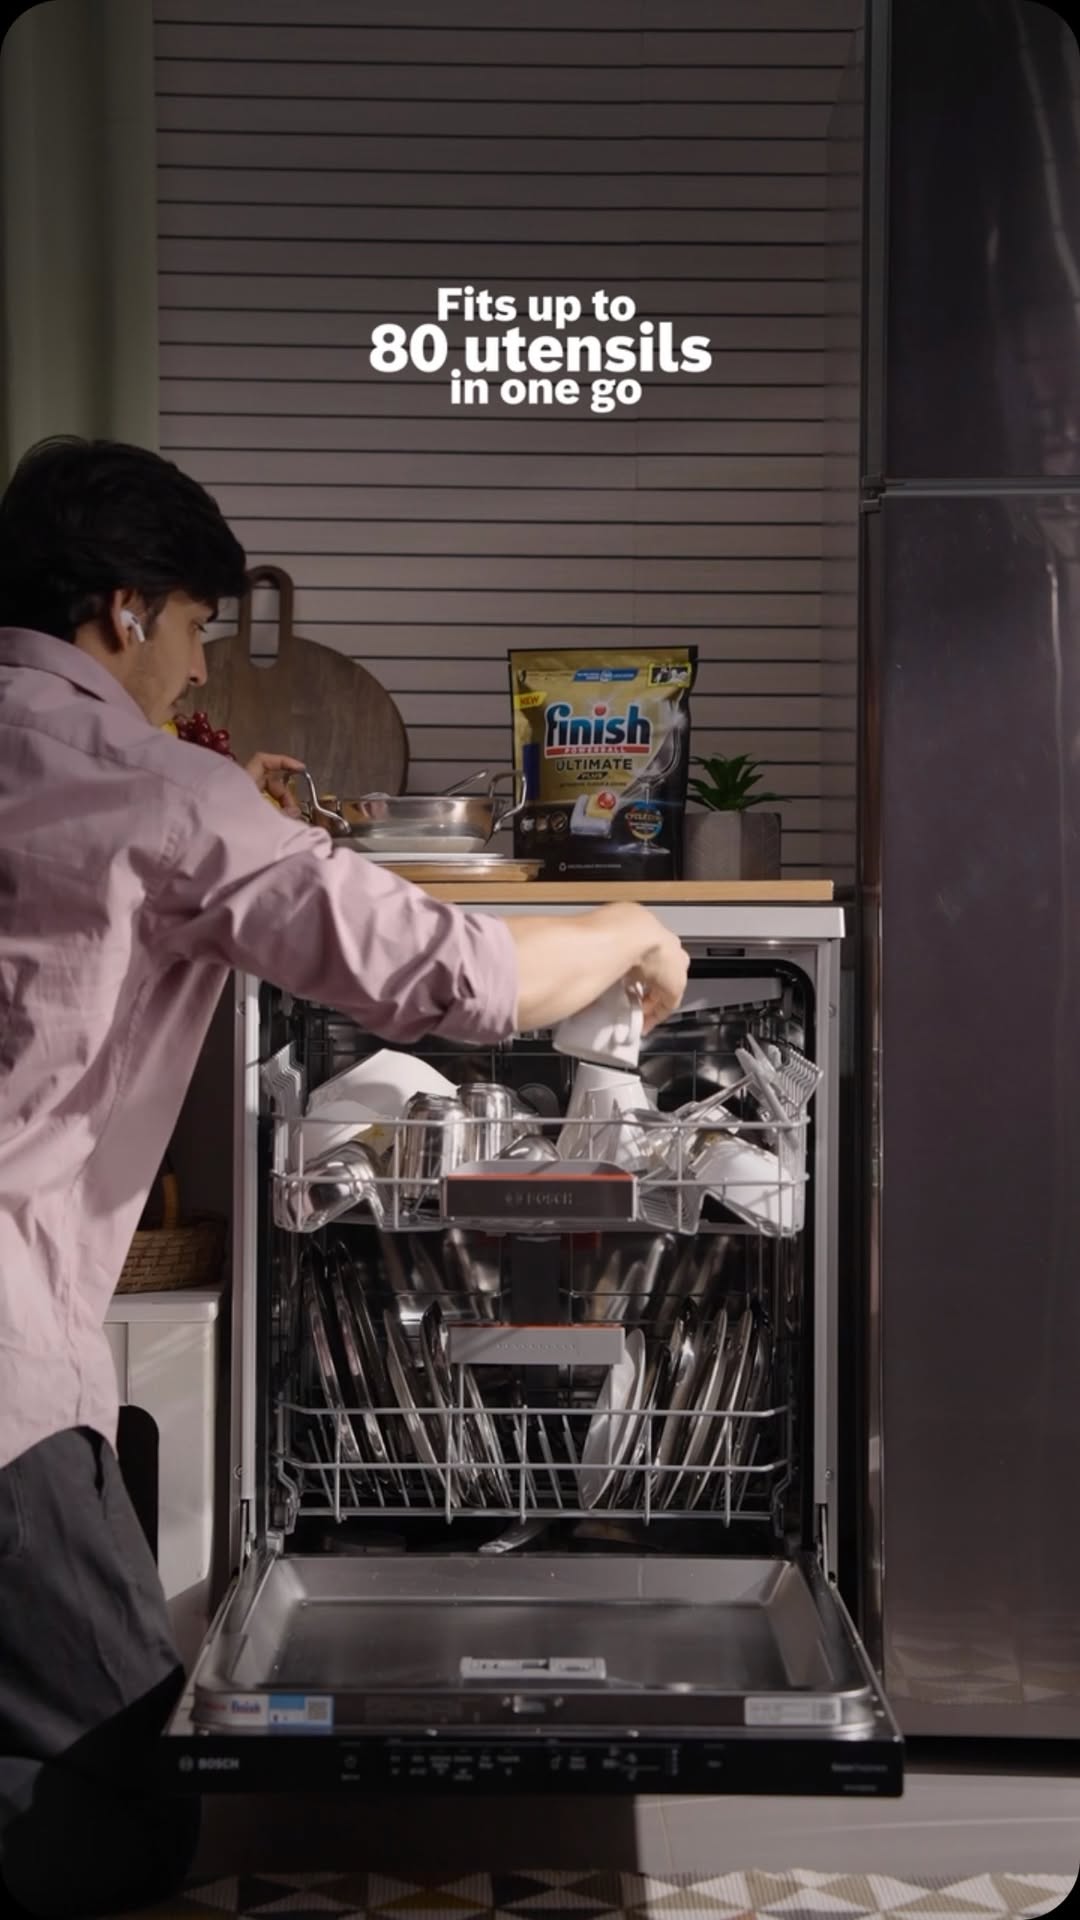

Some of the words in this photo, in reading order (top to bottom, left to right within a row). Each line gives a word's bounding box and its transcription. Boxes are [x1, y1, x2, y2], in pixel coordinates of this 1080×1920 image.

[520, 695, 540, 705] NEW
[546, 703, 651, 746] finish
[556, 759, 633, 771] ULTIMATE
[198, 1757, 241, 1771] BOSCH
